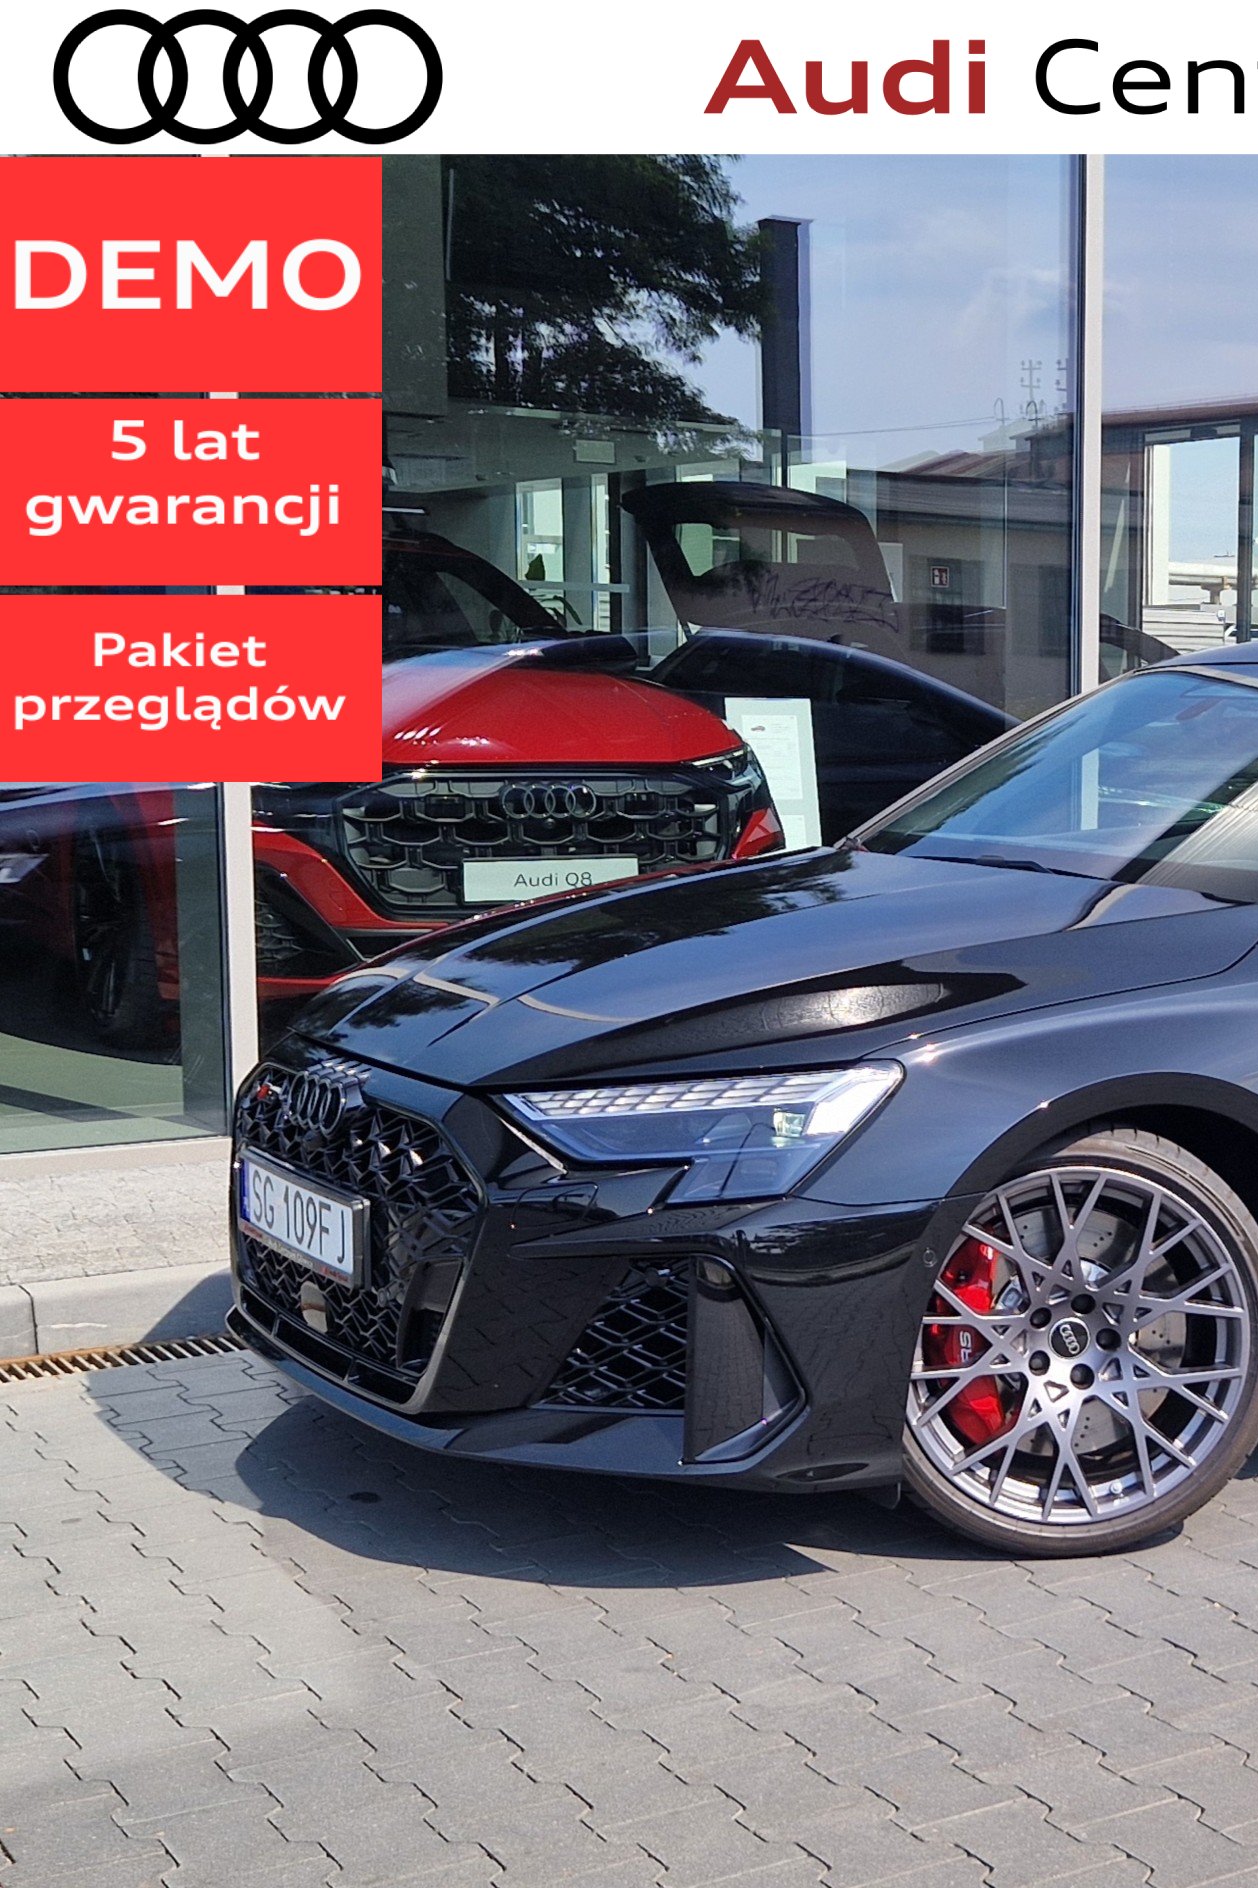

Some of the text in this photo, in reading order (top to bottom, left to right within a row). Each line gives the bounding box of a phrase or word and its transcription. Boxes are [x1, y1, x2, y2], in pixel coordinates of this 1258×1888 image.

[514, 871, 592, 888] Audi Q8
[252, 1169, 275, 1230] SG
[283, 1185, 346, 1264] 109FJ
